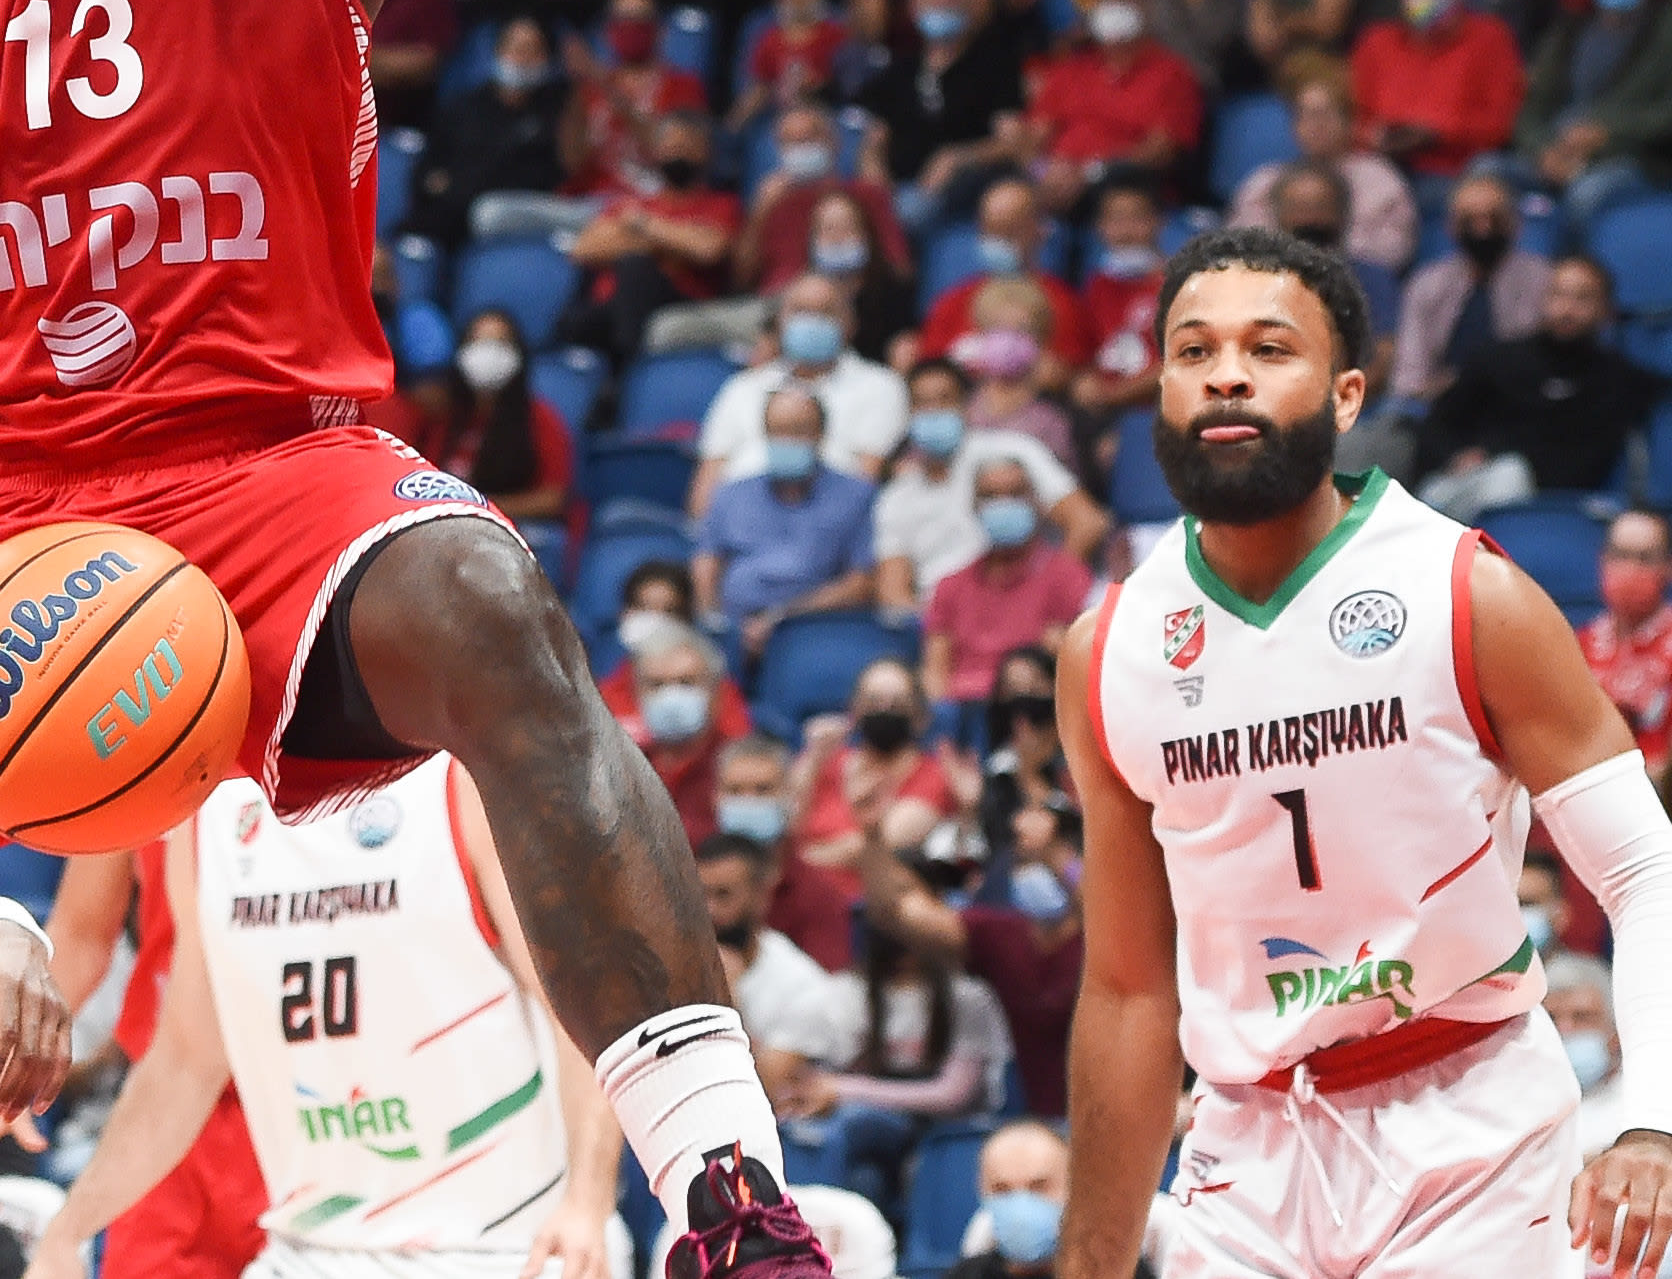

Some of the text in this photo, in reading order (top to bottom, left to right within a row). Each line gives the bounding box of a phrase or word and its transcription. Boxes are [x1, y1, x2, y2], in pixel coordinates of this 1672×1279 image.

[87, 638, 185, 760] EVO
[1161, 728, 1241, 786] PINAR
[1270, 788, 1322, 891] 1
[281, 955, 358, 1043] 20
[1265, 959, 1417, 1019] PINAR
